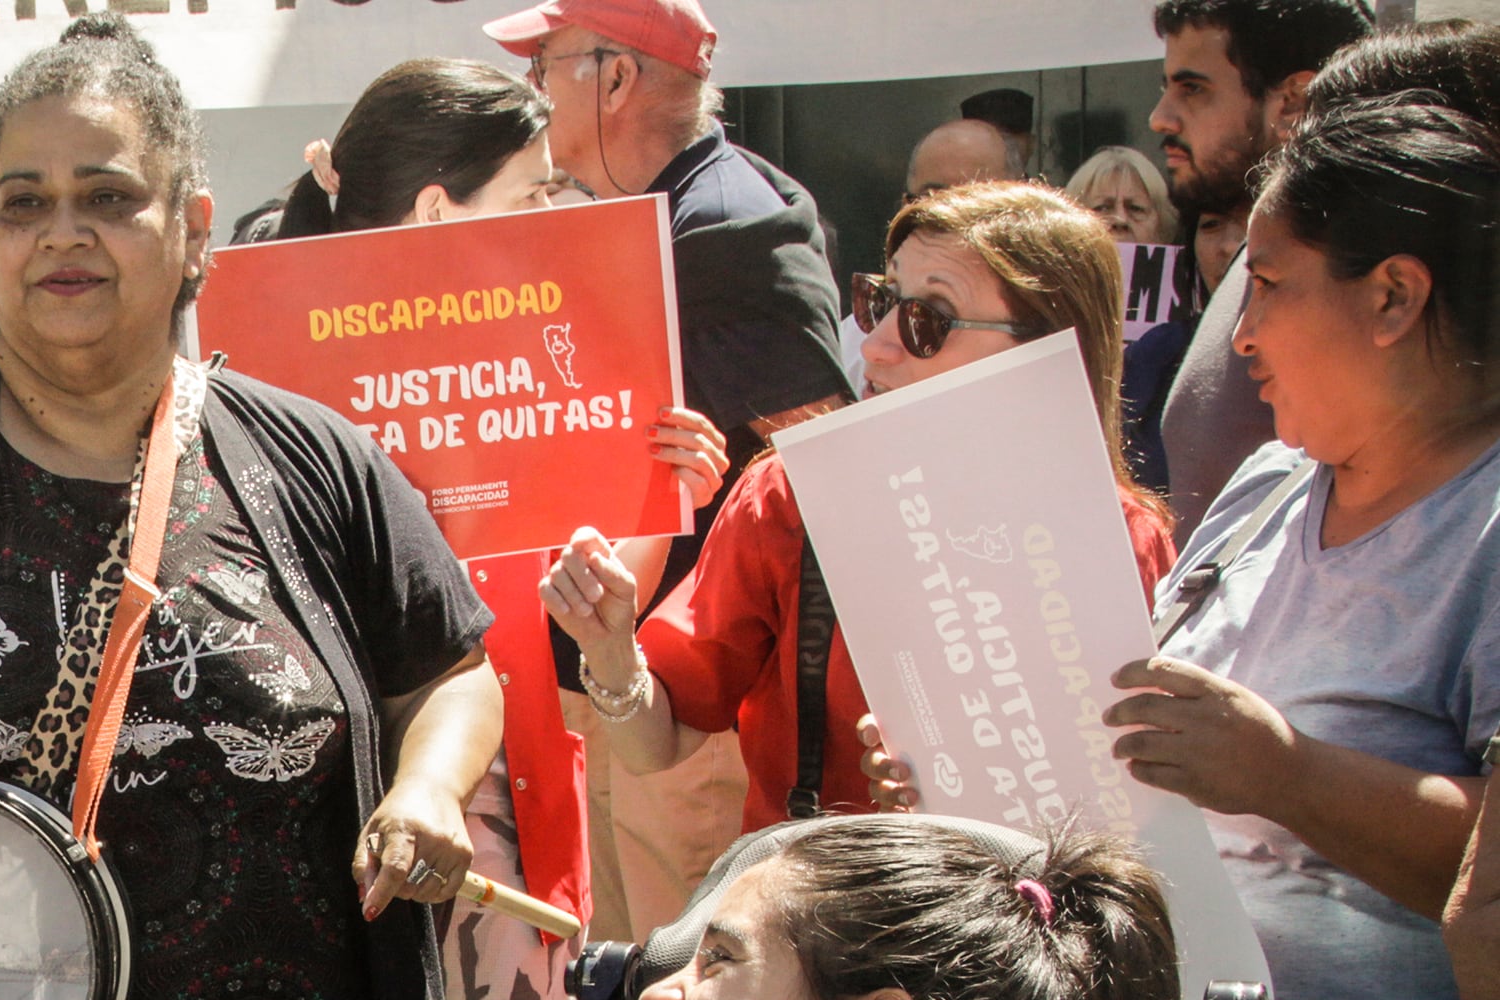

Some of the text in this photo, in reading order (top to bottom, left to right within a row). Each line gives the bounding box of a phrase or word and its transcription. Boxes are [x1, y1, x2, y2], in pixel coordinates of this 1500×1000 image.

[308, 280, 564, 342] DISCAPACIDAD
[350, 356, 547, 413] JUSTICIA,
[419, 413, 466, 451] DE
[477, 389, 634, 443] QUITAS!
[432, 480, 509, 497] FORO PERMANENTE
[432, 489, 510, 508] DISCAPACIDAD
